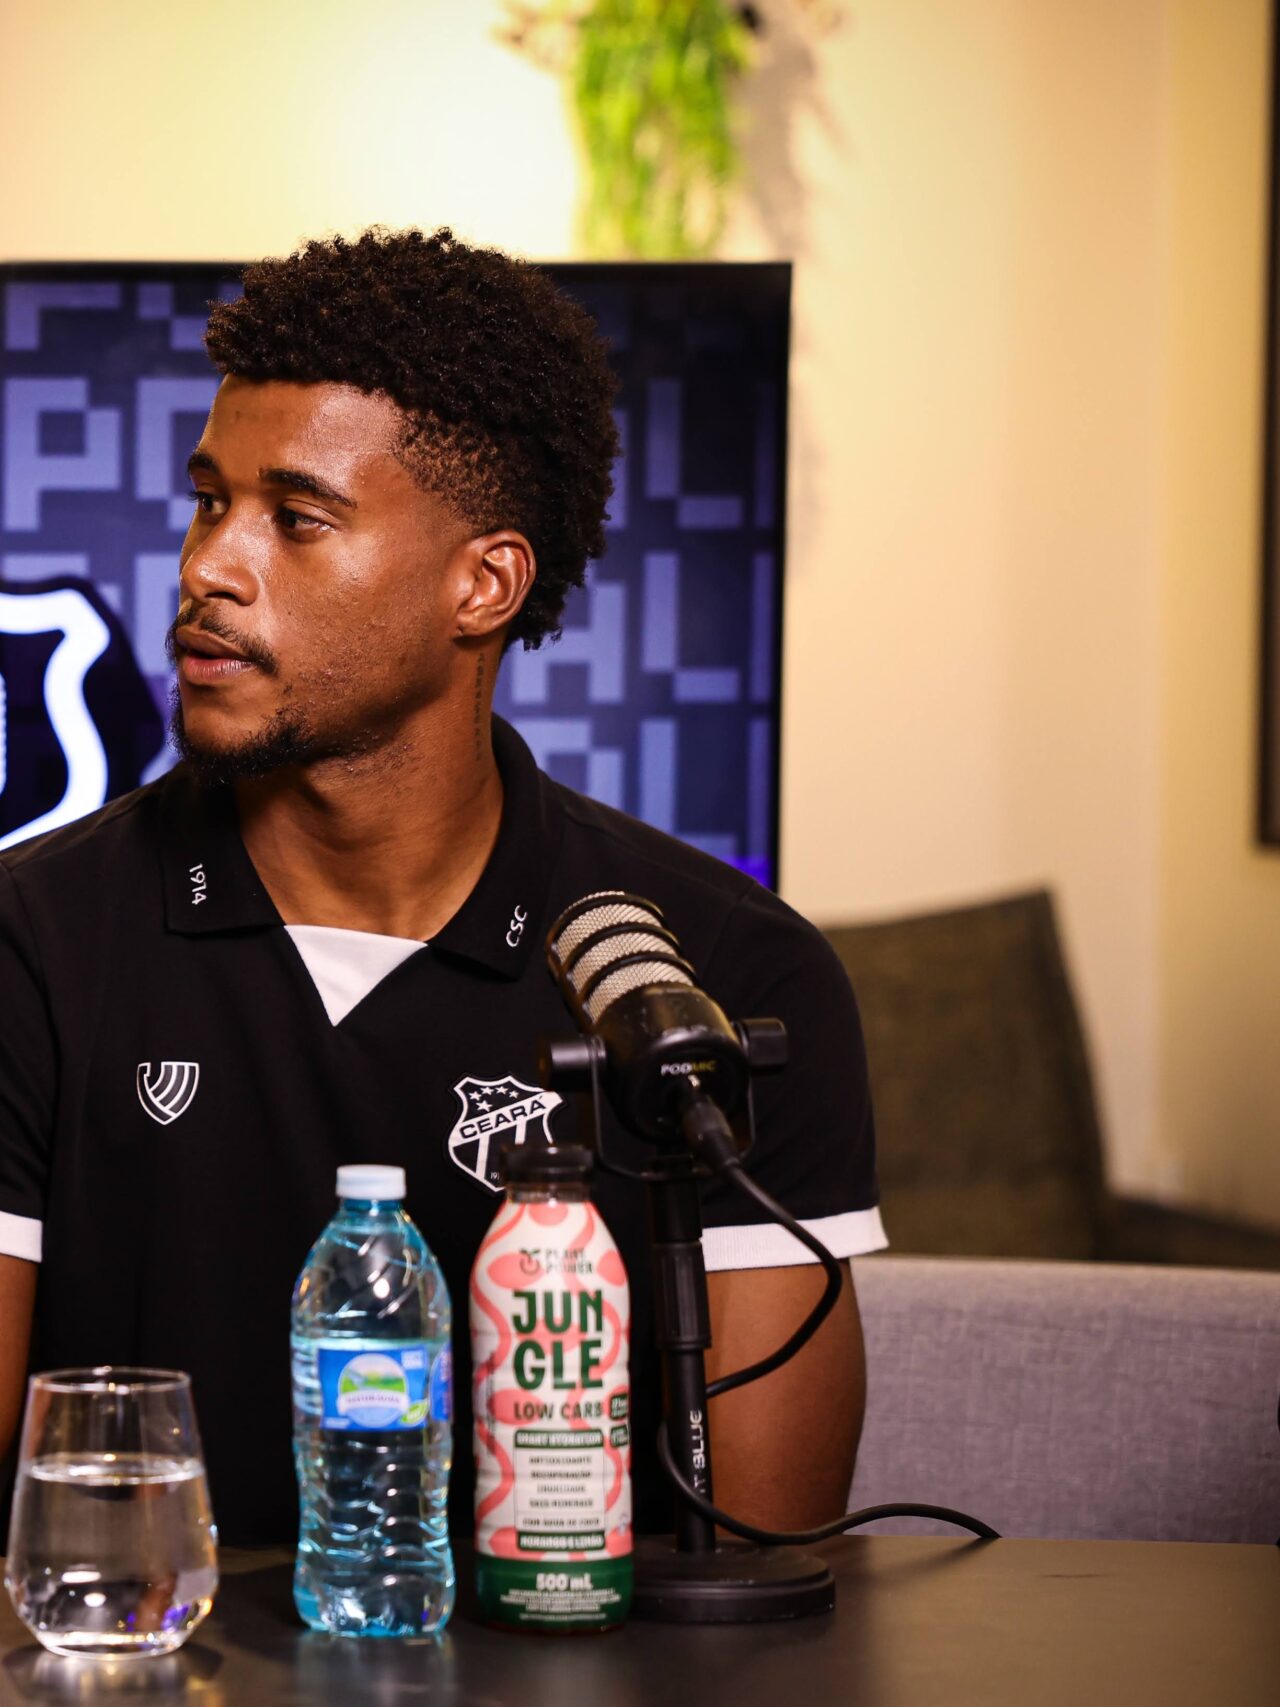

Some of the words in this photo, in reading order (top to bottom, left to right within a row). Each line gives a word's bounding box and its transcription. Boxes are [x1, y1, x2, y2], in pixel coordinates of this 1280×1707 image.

[189, 863, 207, 905] 1914
[506, 904, 528, 948] CSC
[459, 1095, 546, 1140] CEARÁ
[512, 1289, 603, 1334] JUN
[514, 1339, 603, 1391] GLE
[513, 1402, 554, 1420] LOW
[560, 1401, 603, 1420] CARB
[690, 1409, 706, 1469] BLUE
[536, 1572, 568, 1592] 500
